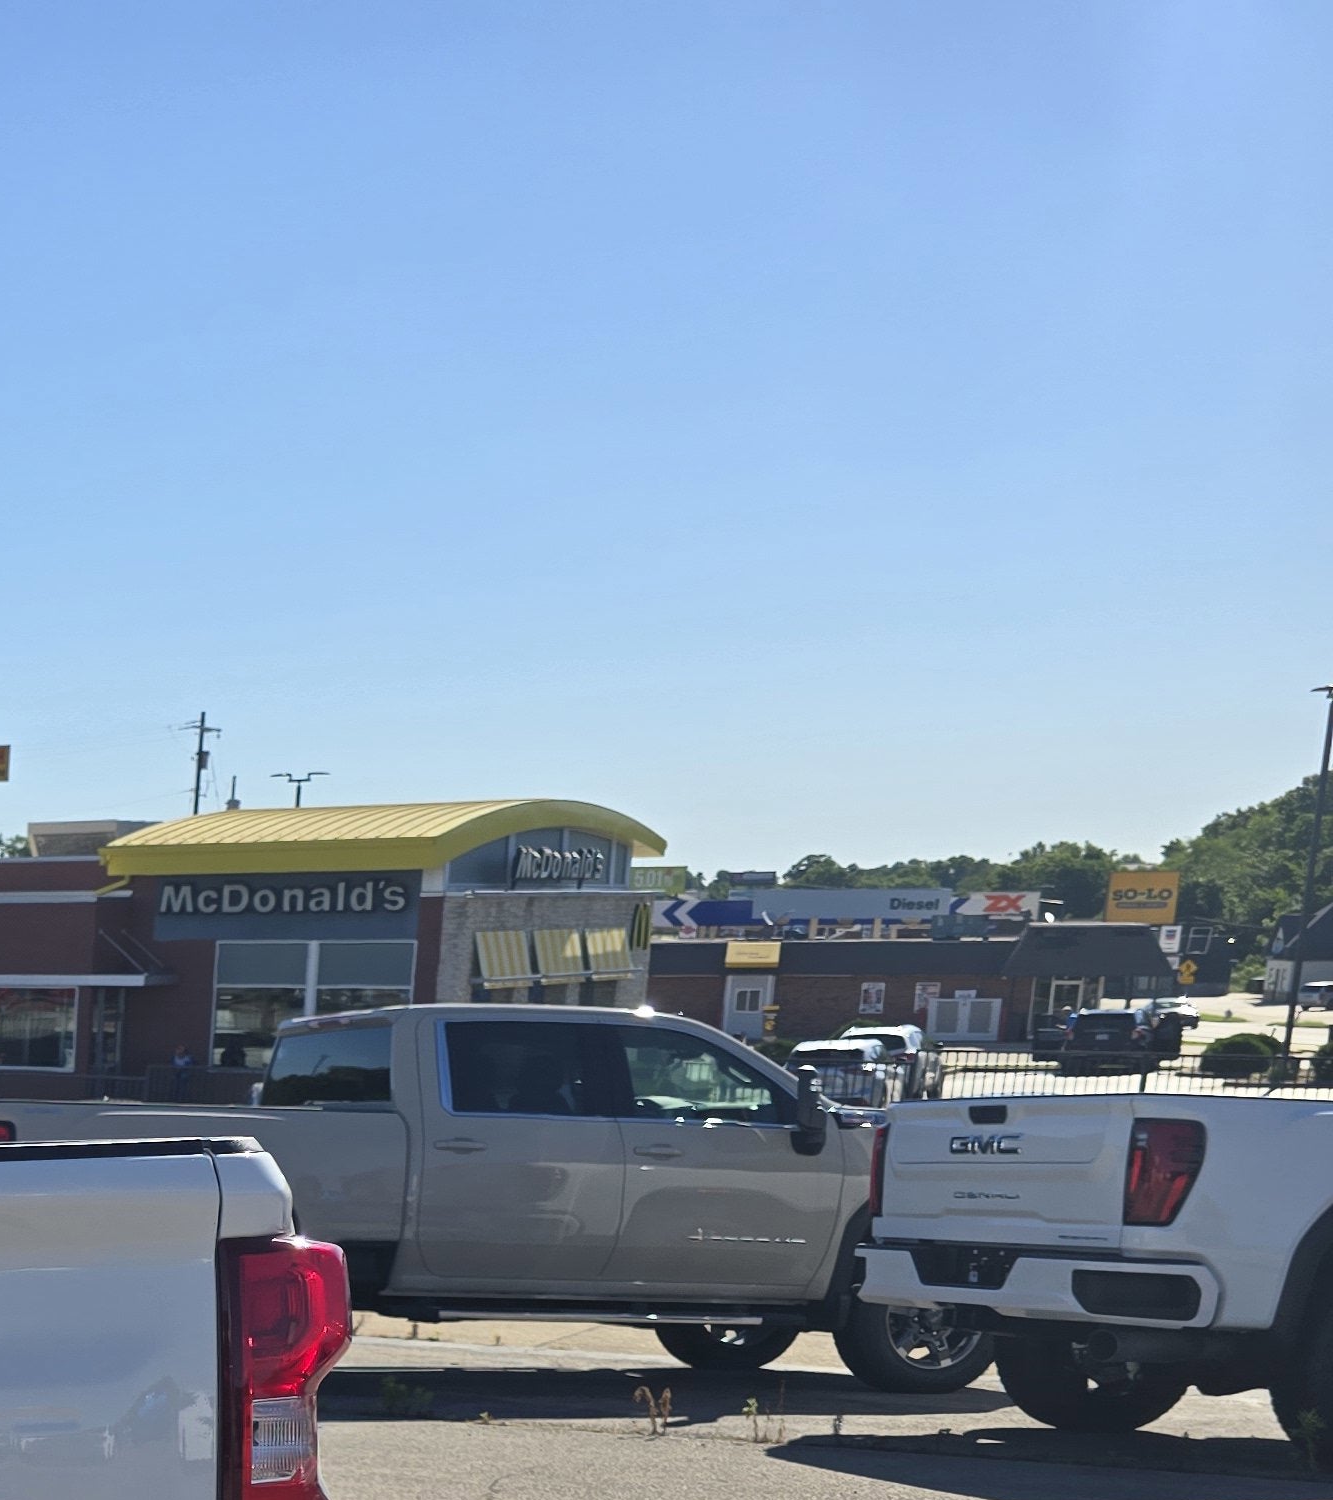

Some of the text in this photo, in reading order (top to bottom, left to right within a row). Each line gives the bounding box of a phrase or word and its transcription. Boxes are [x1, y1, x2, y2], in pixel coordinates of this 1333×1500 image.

[515, 845, 606, 881] McDonald's
[159, 880, 406, 915] McDonald's
[889, 897, 940, 911] Diesel
[1112, 888, 1173, 901] SO-LO
[950, 1134, 1023, 1155] GMC
